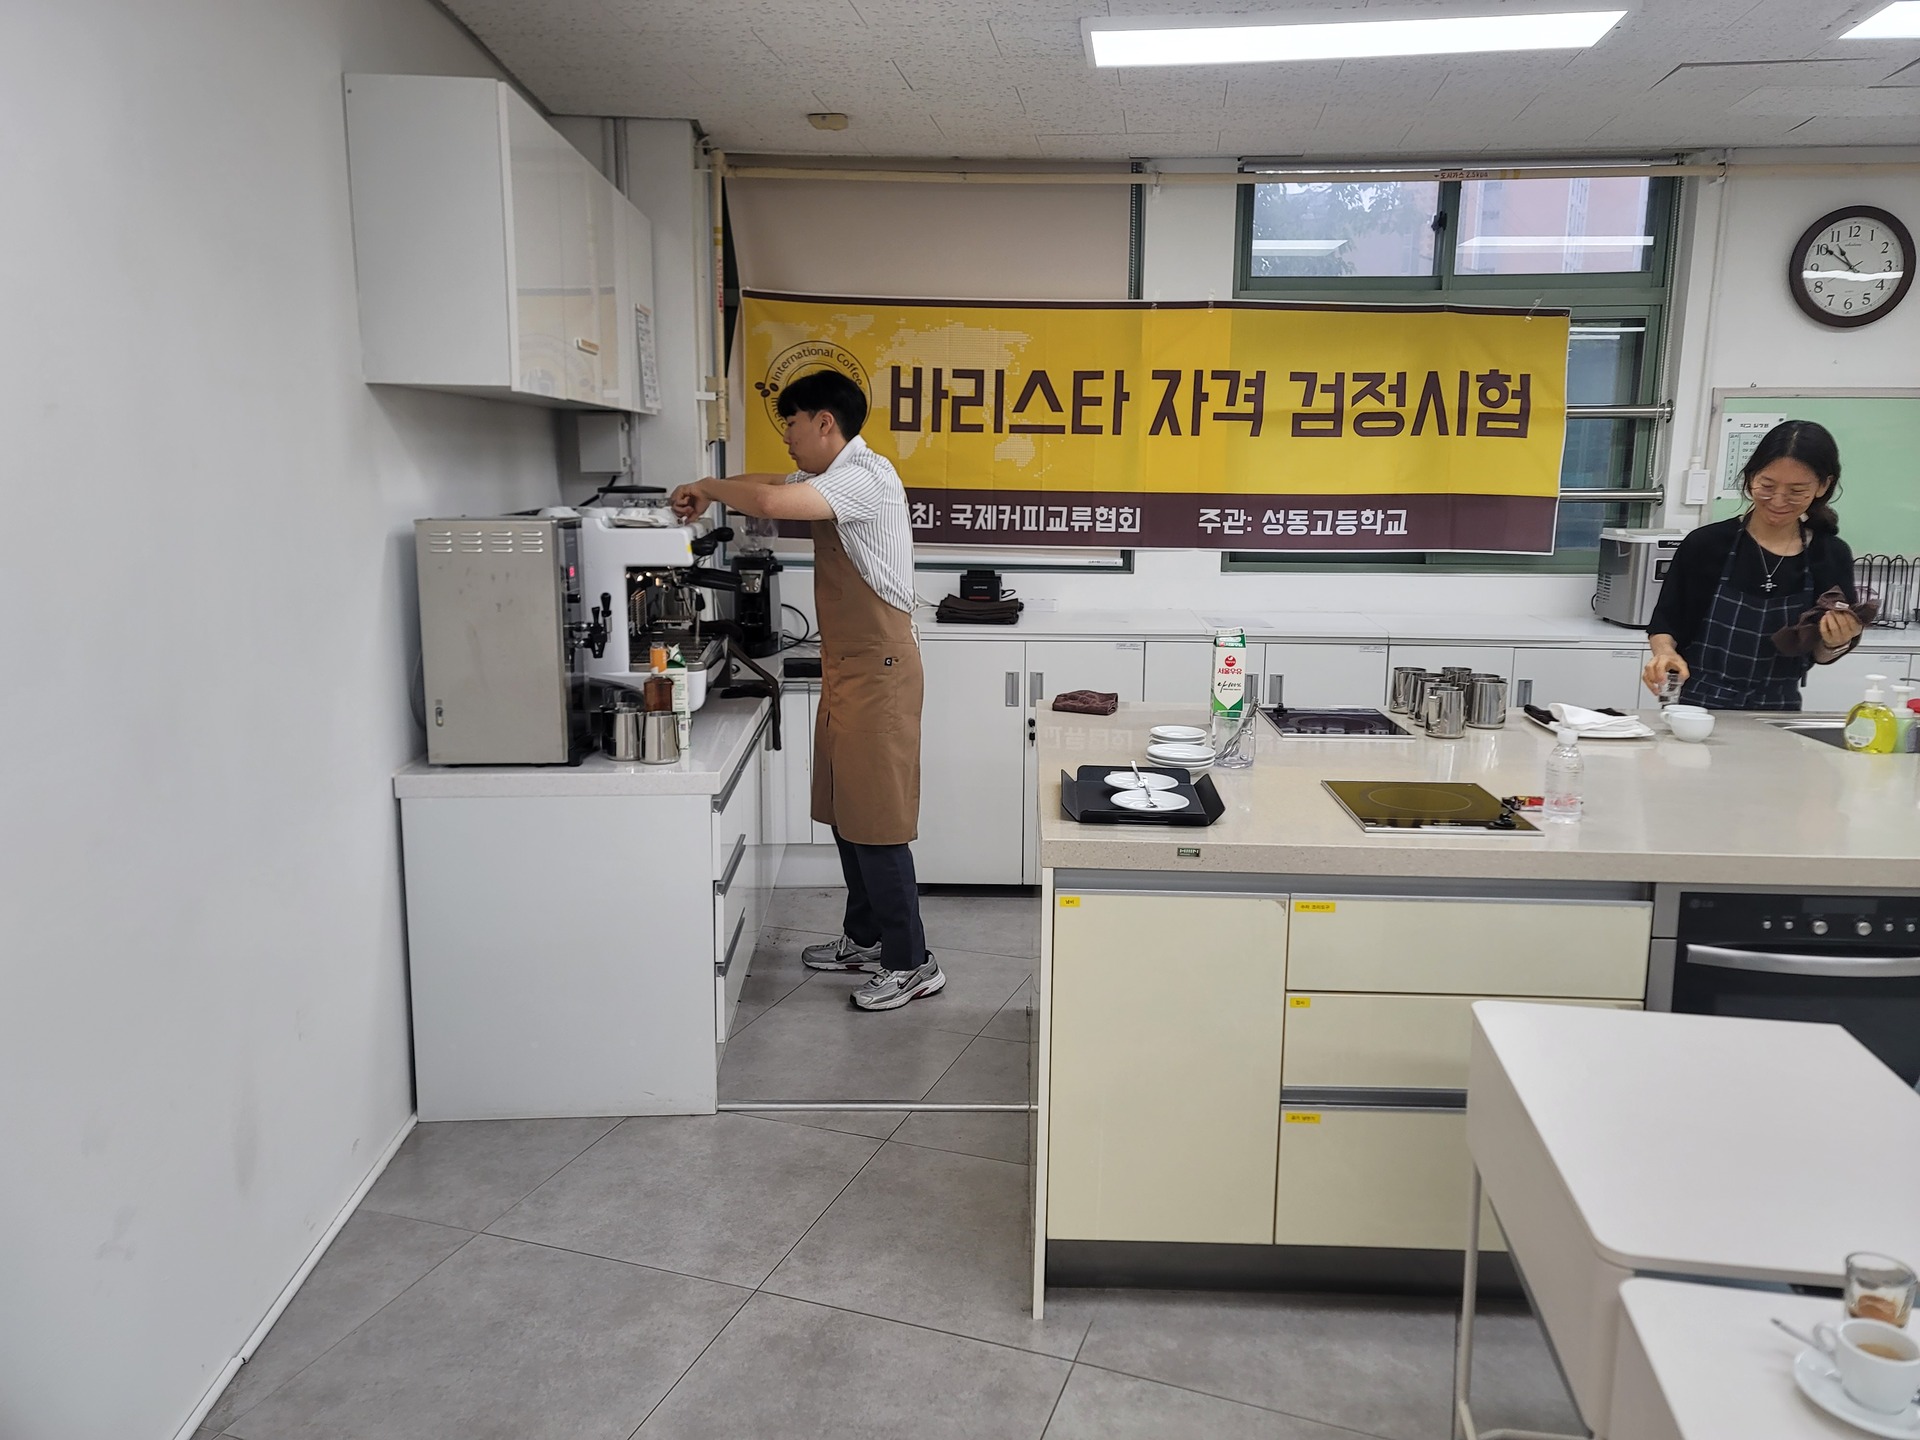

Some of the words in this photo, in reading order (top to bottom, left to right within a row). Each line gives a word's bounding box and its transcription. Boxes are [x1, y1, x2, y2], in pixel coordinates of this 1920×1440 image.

[1831, 231, 1840, 242] 11
[1849, 226, 1861, 238] 12
[1870, 230, 1875, 241] 1
[1816, 244, 1828, 255] 10
[1881, 242, 1889, 254] 2
[1883, 260, 1892, 272] 3
[1814, 281, 1823, 293] 8
[1875, 279, 1884, 290] 4
[1827, 294, 1835, 306] 7
[1844, 298, 1852, 310] 6
[1862, 293, 1871, 305] 5
[771, 346, 834, 382] International
[836, 353, 863, 386] Coffee
[890, 366, 1130, 435] 바리스타
[1149, 369, 1266, 437] 자격
[1289, 369, 1531, 438] 검정시험
[912, 502, 941, 529] 최:
[950, 503, 1140, 534] 국제커피교류협회
[1198, 508, 1253, 534] 주관:
[1262, 509, 1408, 536] 성동고등학교
[1217, 667, 1243, 675] 서울우유
